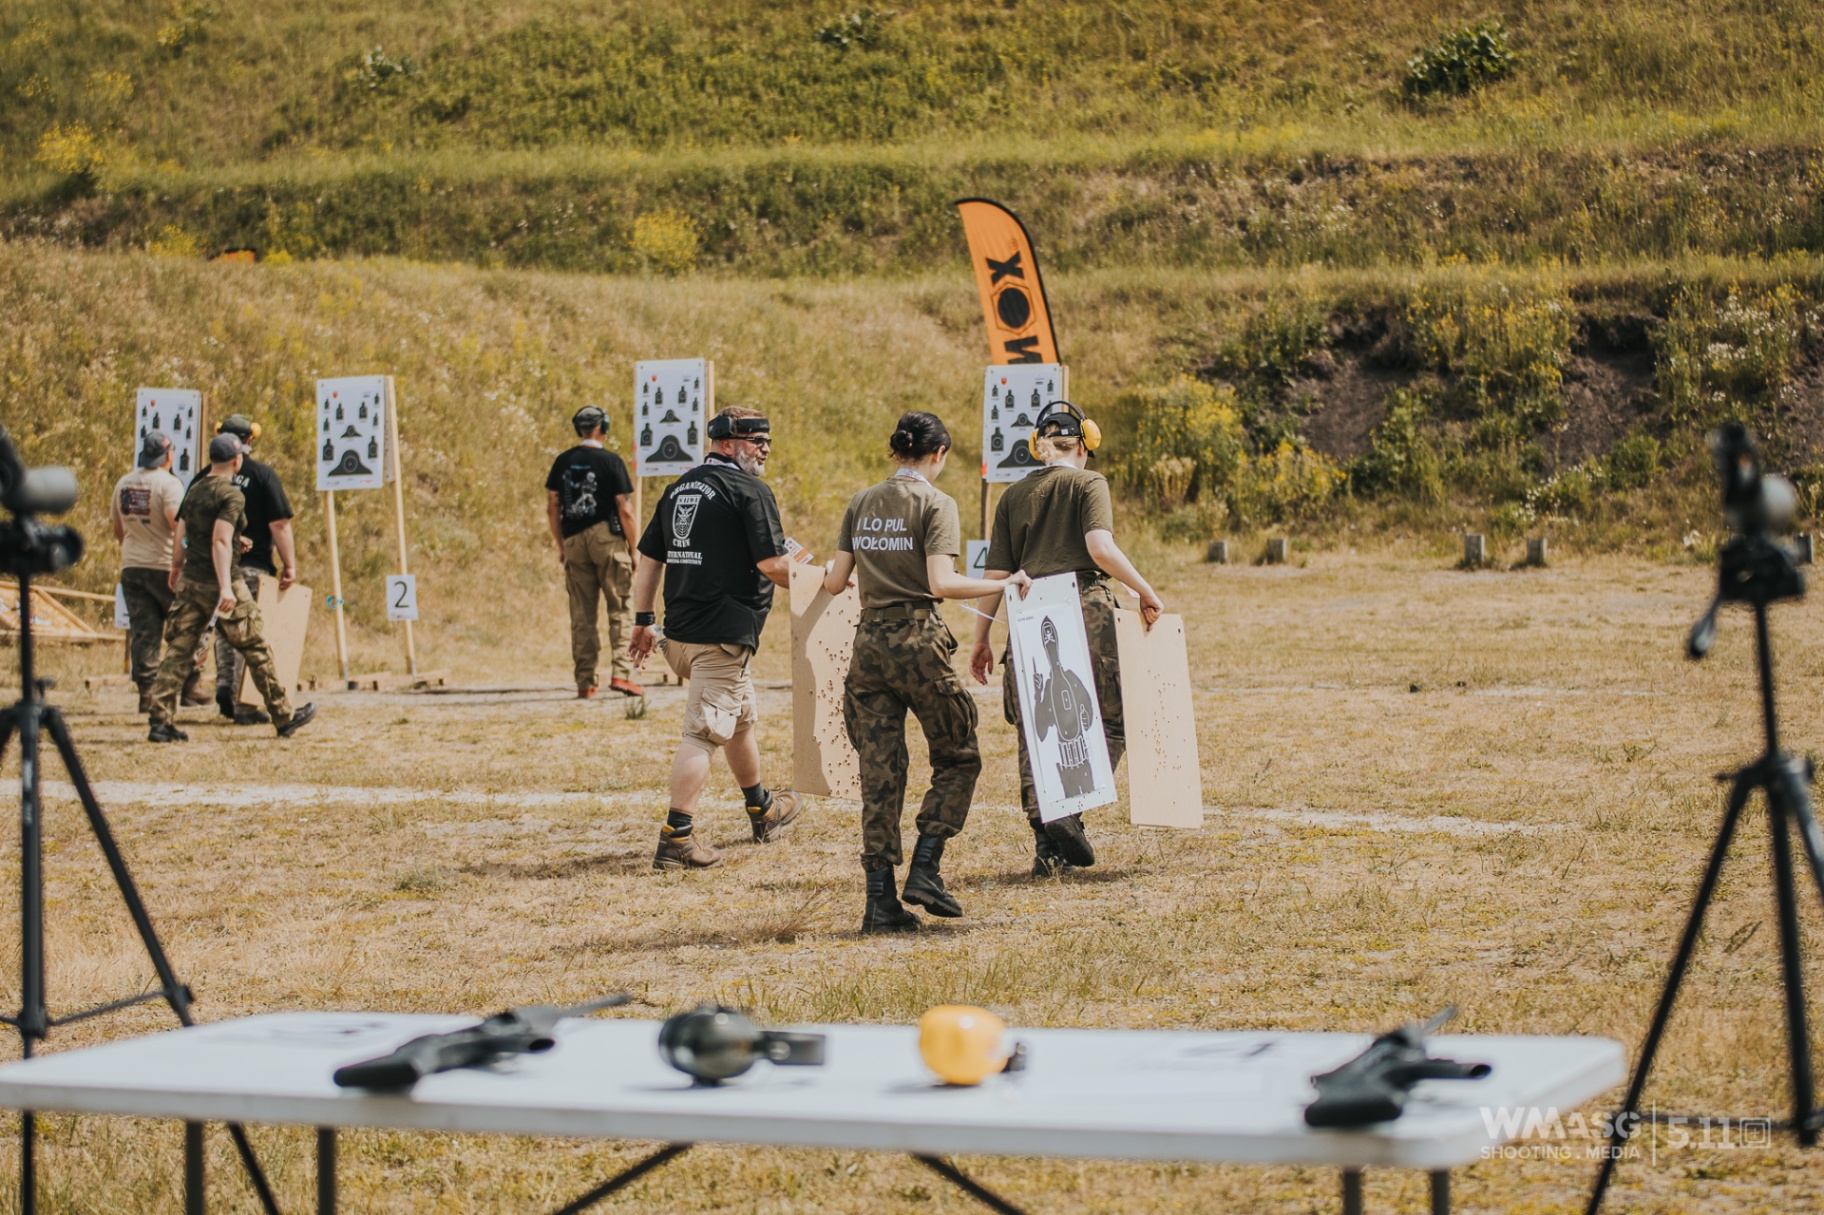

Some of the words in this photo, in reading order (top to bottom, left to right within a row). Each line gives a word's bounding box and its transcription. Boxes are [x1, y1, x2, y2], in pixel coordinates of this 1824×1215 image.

[863, 517, 882, 532] LO
[884, 518, 907, 532] PUL
[852, 535, 913, 551] WOŁOMIN
[394, 581, 410, 608] 2
